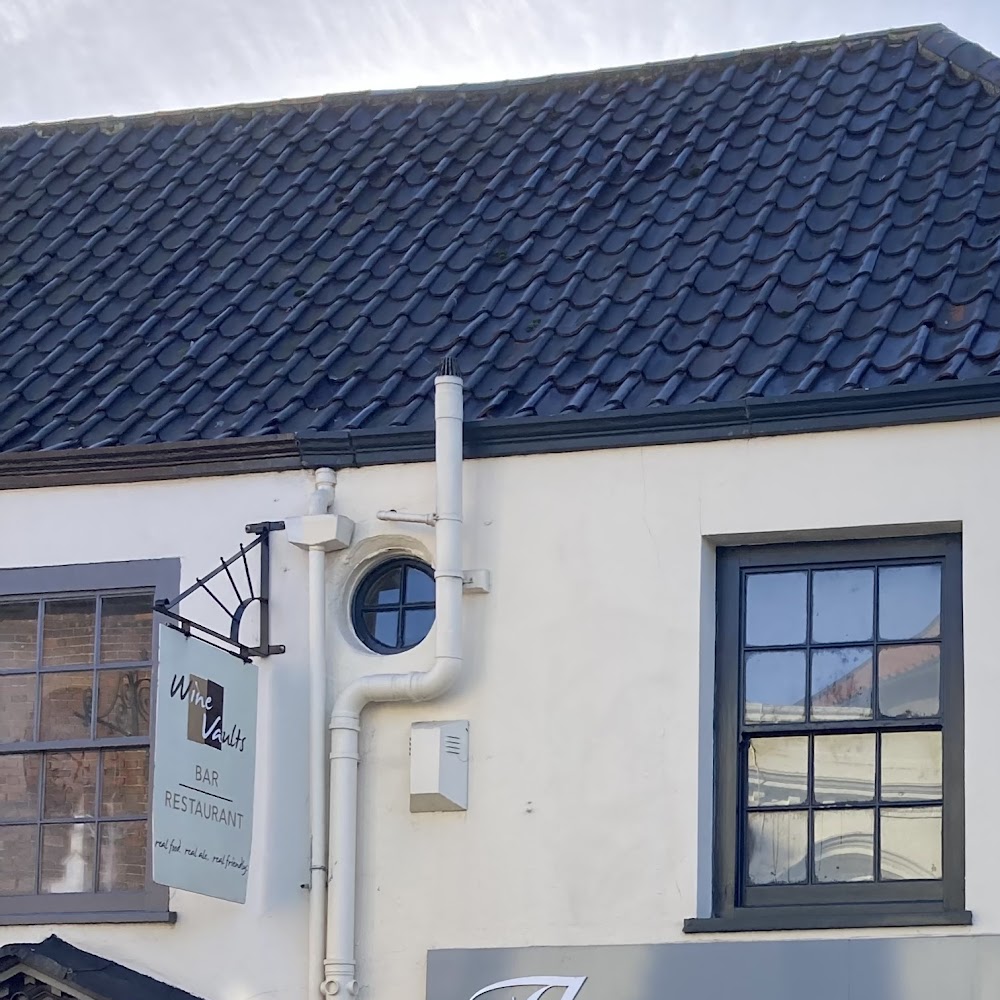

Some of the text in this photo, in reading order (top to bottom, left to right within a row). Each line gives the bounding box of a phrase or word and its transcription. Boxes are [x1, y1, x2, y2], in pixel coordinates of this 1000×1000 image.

[170, 674, 213, 711] Wine
[201, 712, 247, 752] Vaults
[195, 764, 220, 788] BAR
[165, 790, 244, 829] RESTAURANT
